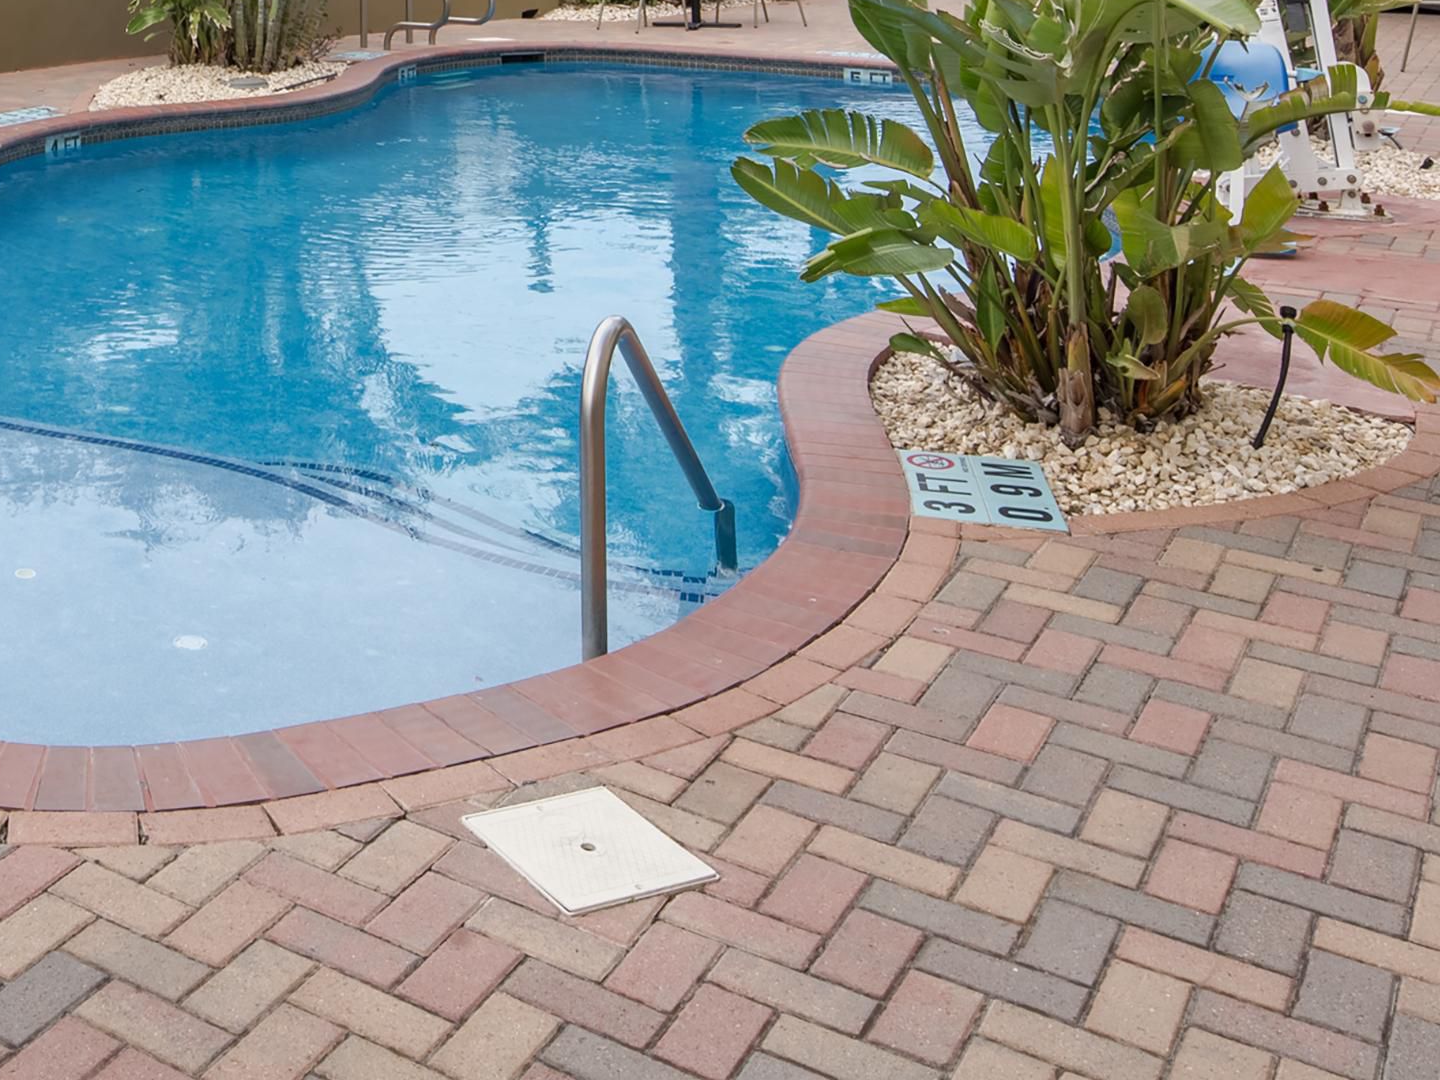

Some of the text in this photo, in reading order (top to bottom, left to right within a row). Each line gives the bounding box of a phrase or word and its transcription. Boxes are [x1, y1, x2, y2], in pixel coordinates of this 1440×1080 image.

[981, 462, 1035, 480] M
[916, 472, 976, 514] 3 FT
